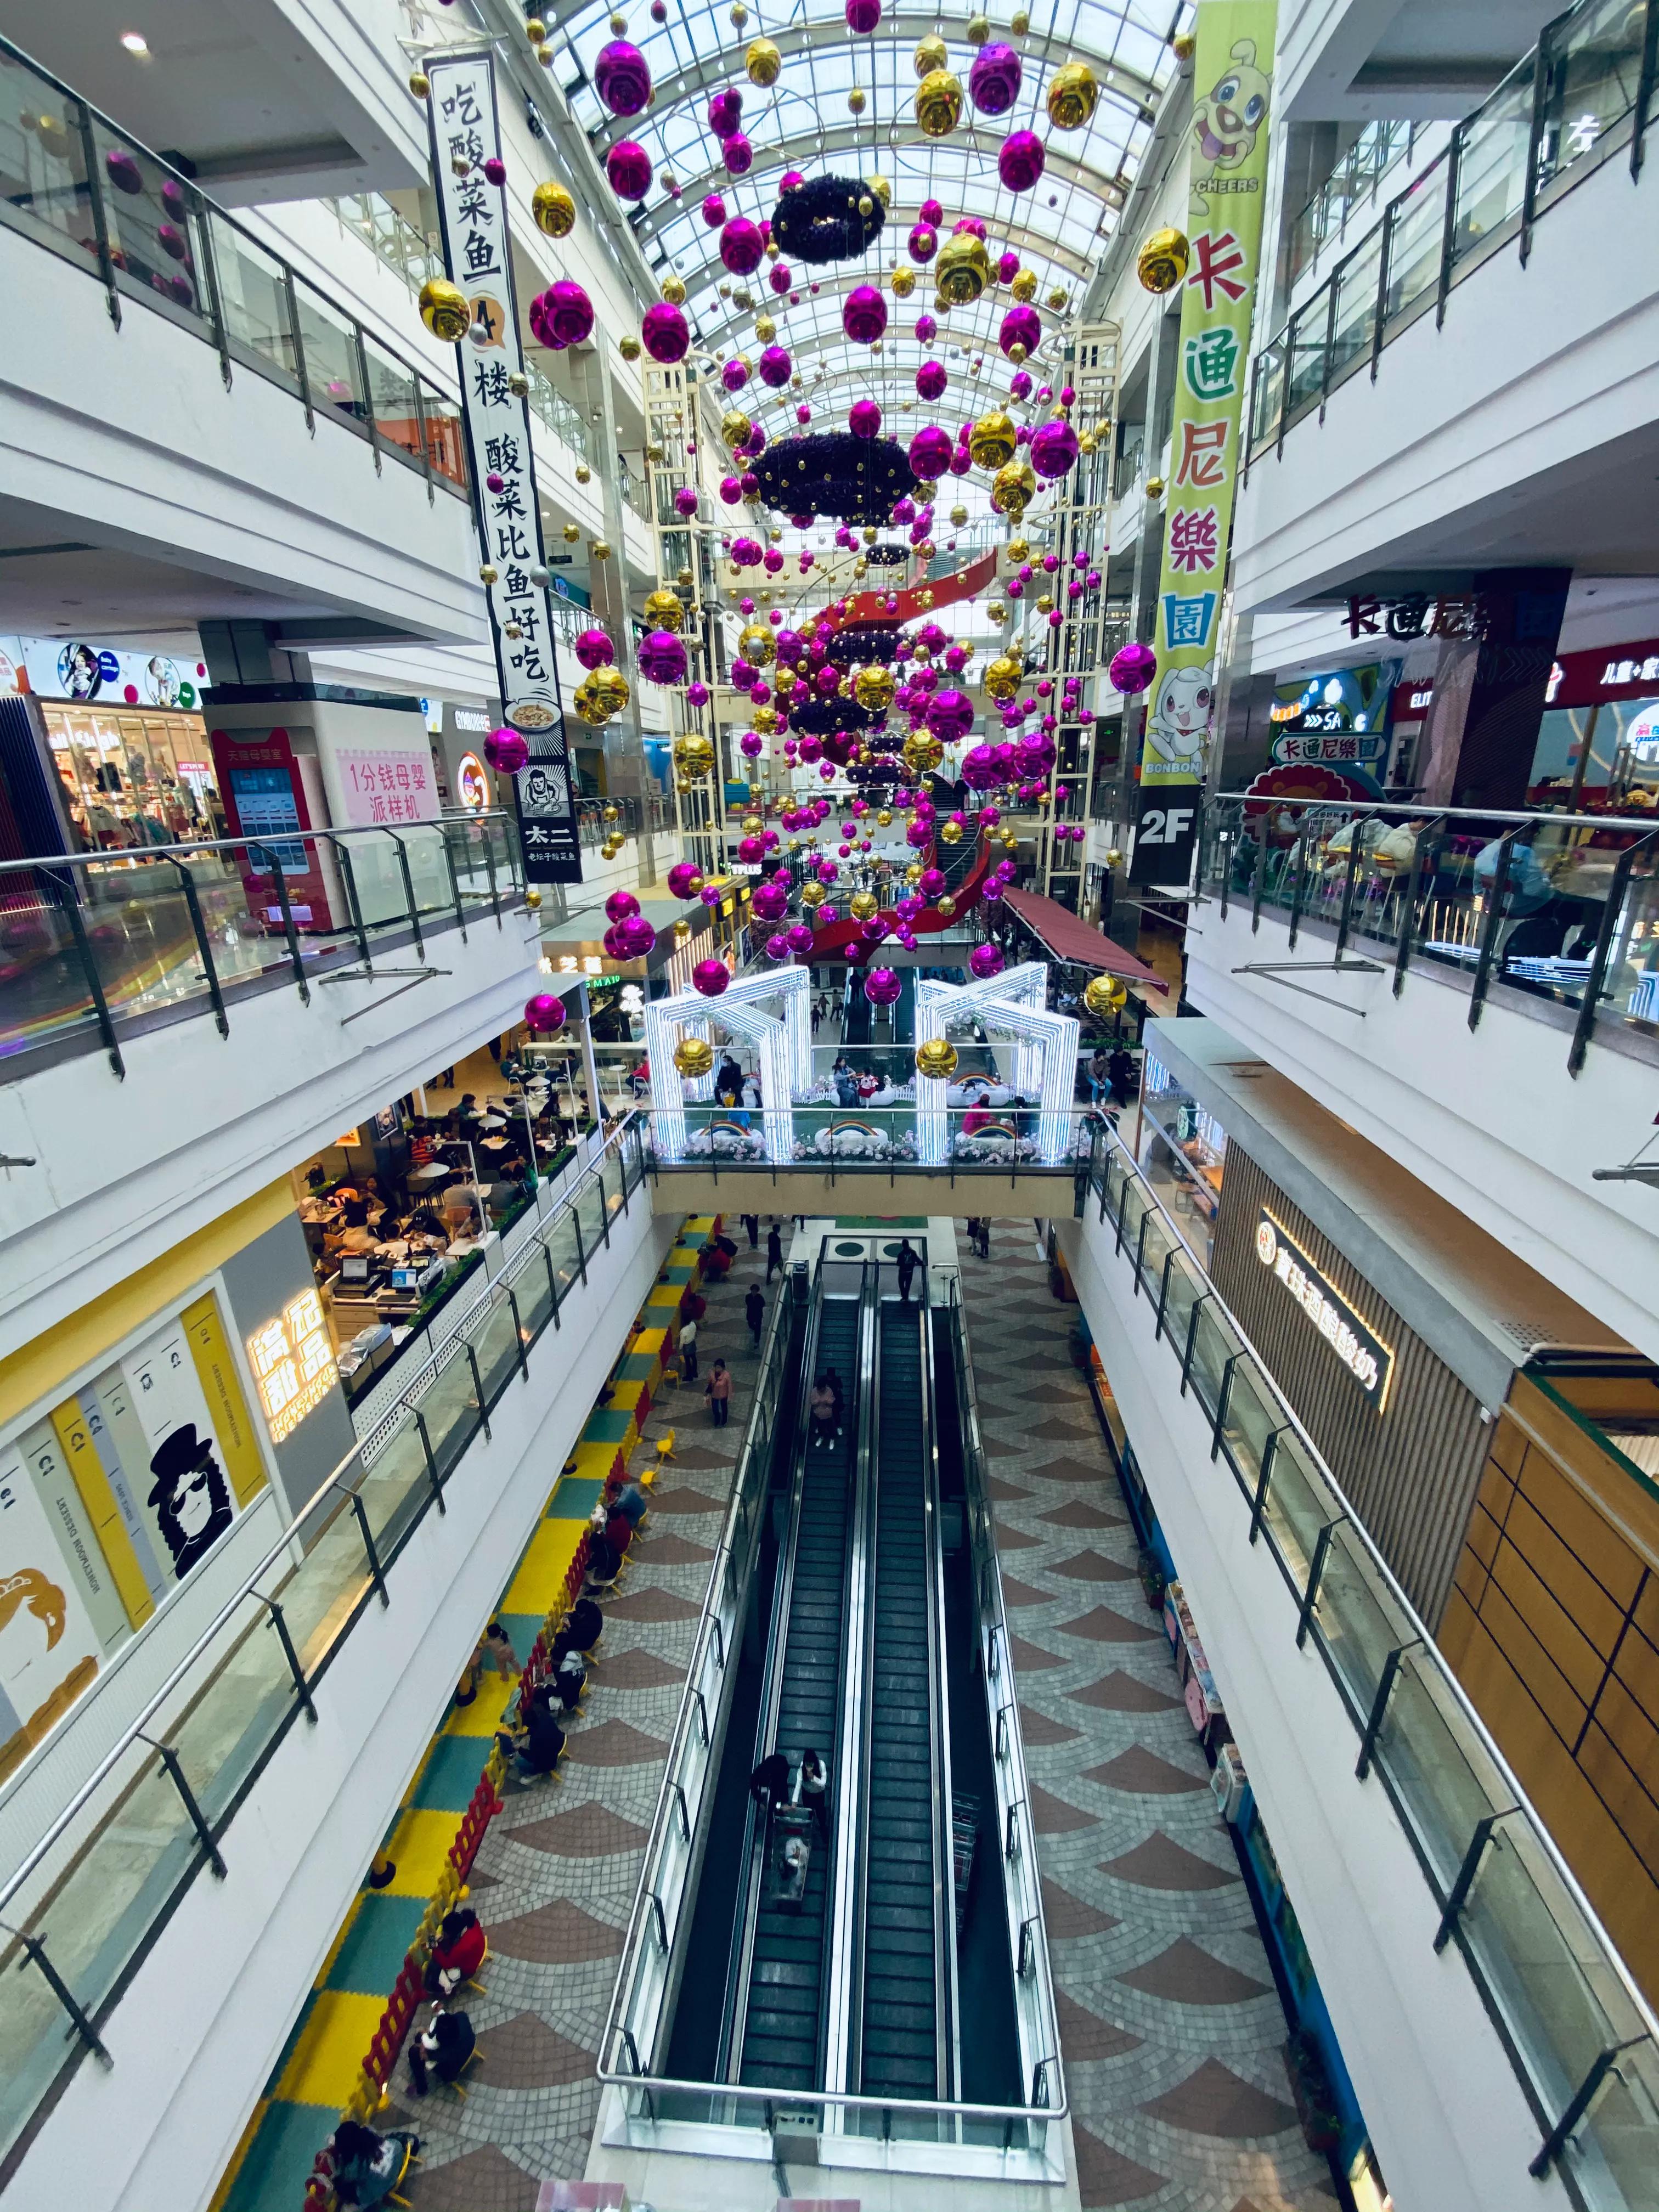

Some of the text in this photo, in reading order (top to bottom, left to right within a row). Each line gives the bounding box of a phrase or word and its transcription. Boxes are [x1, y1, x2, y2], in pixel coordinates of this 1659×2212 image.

[1195, 178, 1259, 194] CHEERS
[1283, 737, 1379, 759] 卡通尼樂園
[350, 763, 426, 792] 1分钱母婴
[1146, 761, 1201, 774] BONBON
[369, 794, 420, 823] 派样机
[525, 825, 574, 844] 太二
[1138, 809, 1194, 844] 2F
[528, 852, 576, 861] 老坛子酸菜鱼
[56, 1497, 100, 1595] HONEYMOON DESSERT
